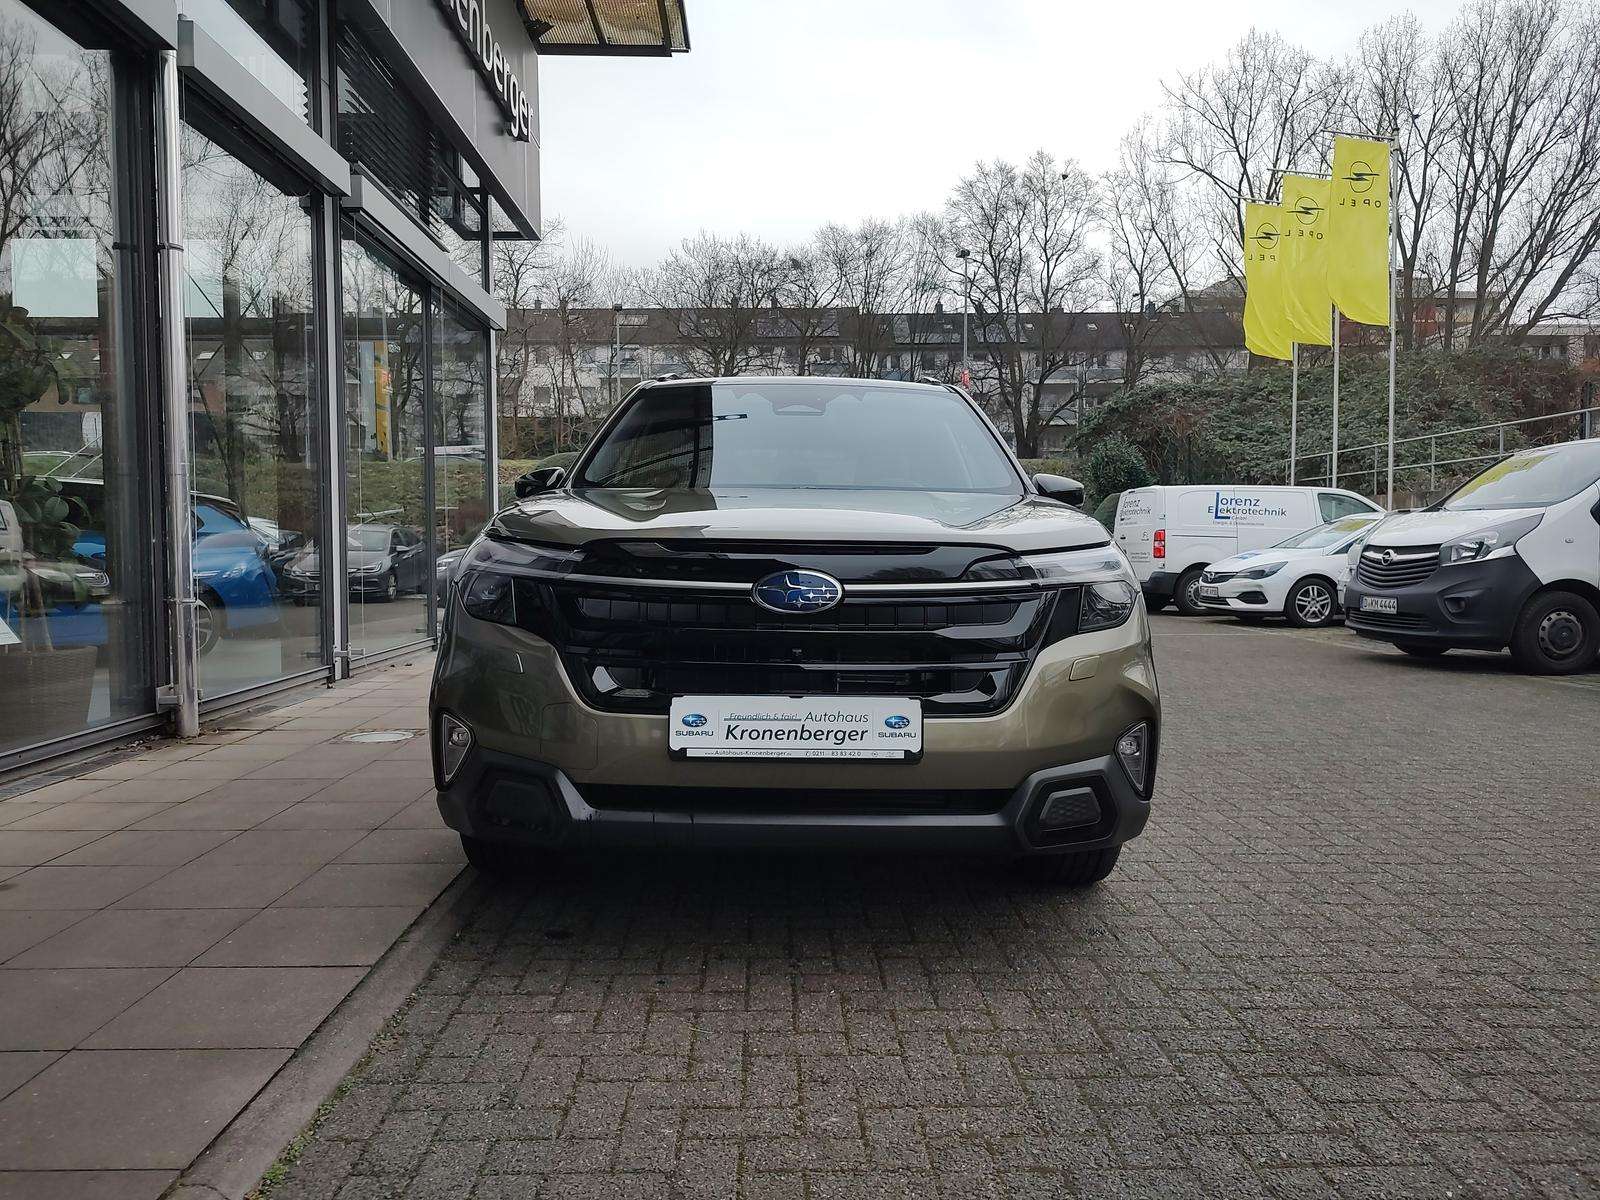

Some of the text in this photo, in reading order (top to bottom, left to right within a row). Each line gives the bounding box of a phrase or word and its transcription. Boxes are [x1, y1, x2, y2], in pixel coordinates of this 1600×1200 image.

[450, 0, 534, 143] enberger
[1214, 492, 1260, 519] Lorenz
[729, 712, 771, 721] Freundlich
[804, 710, 869, 722] Autohaus
[725, 724, 869, 745] Kronenberger
